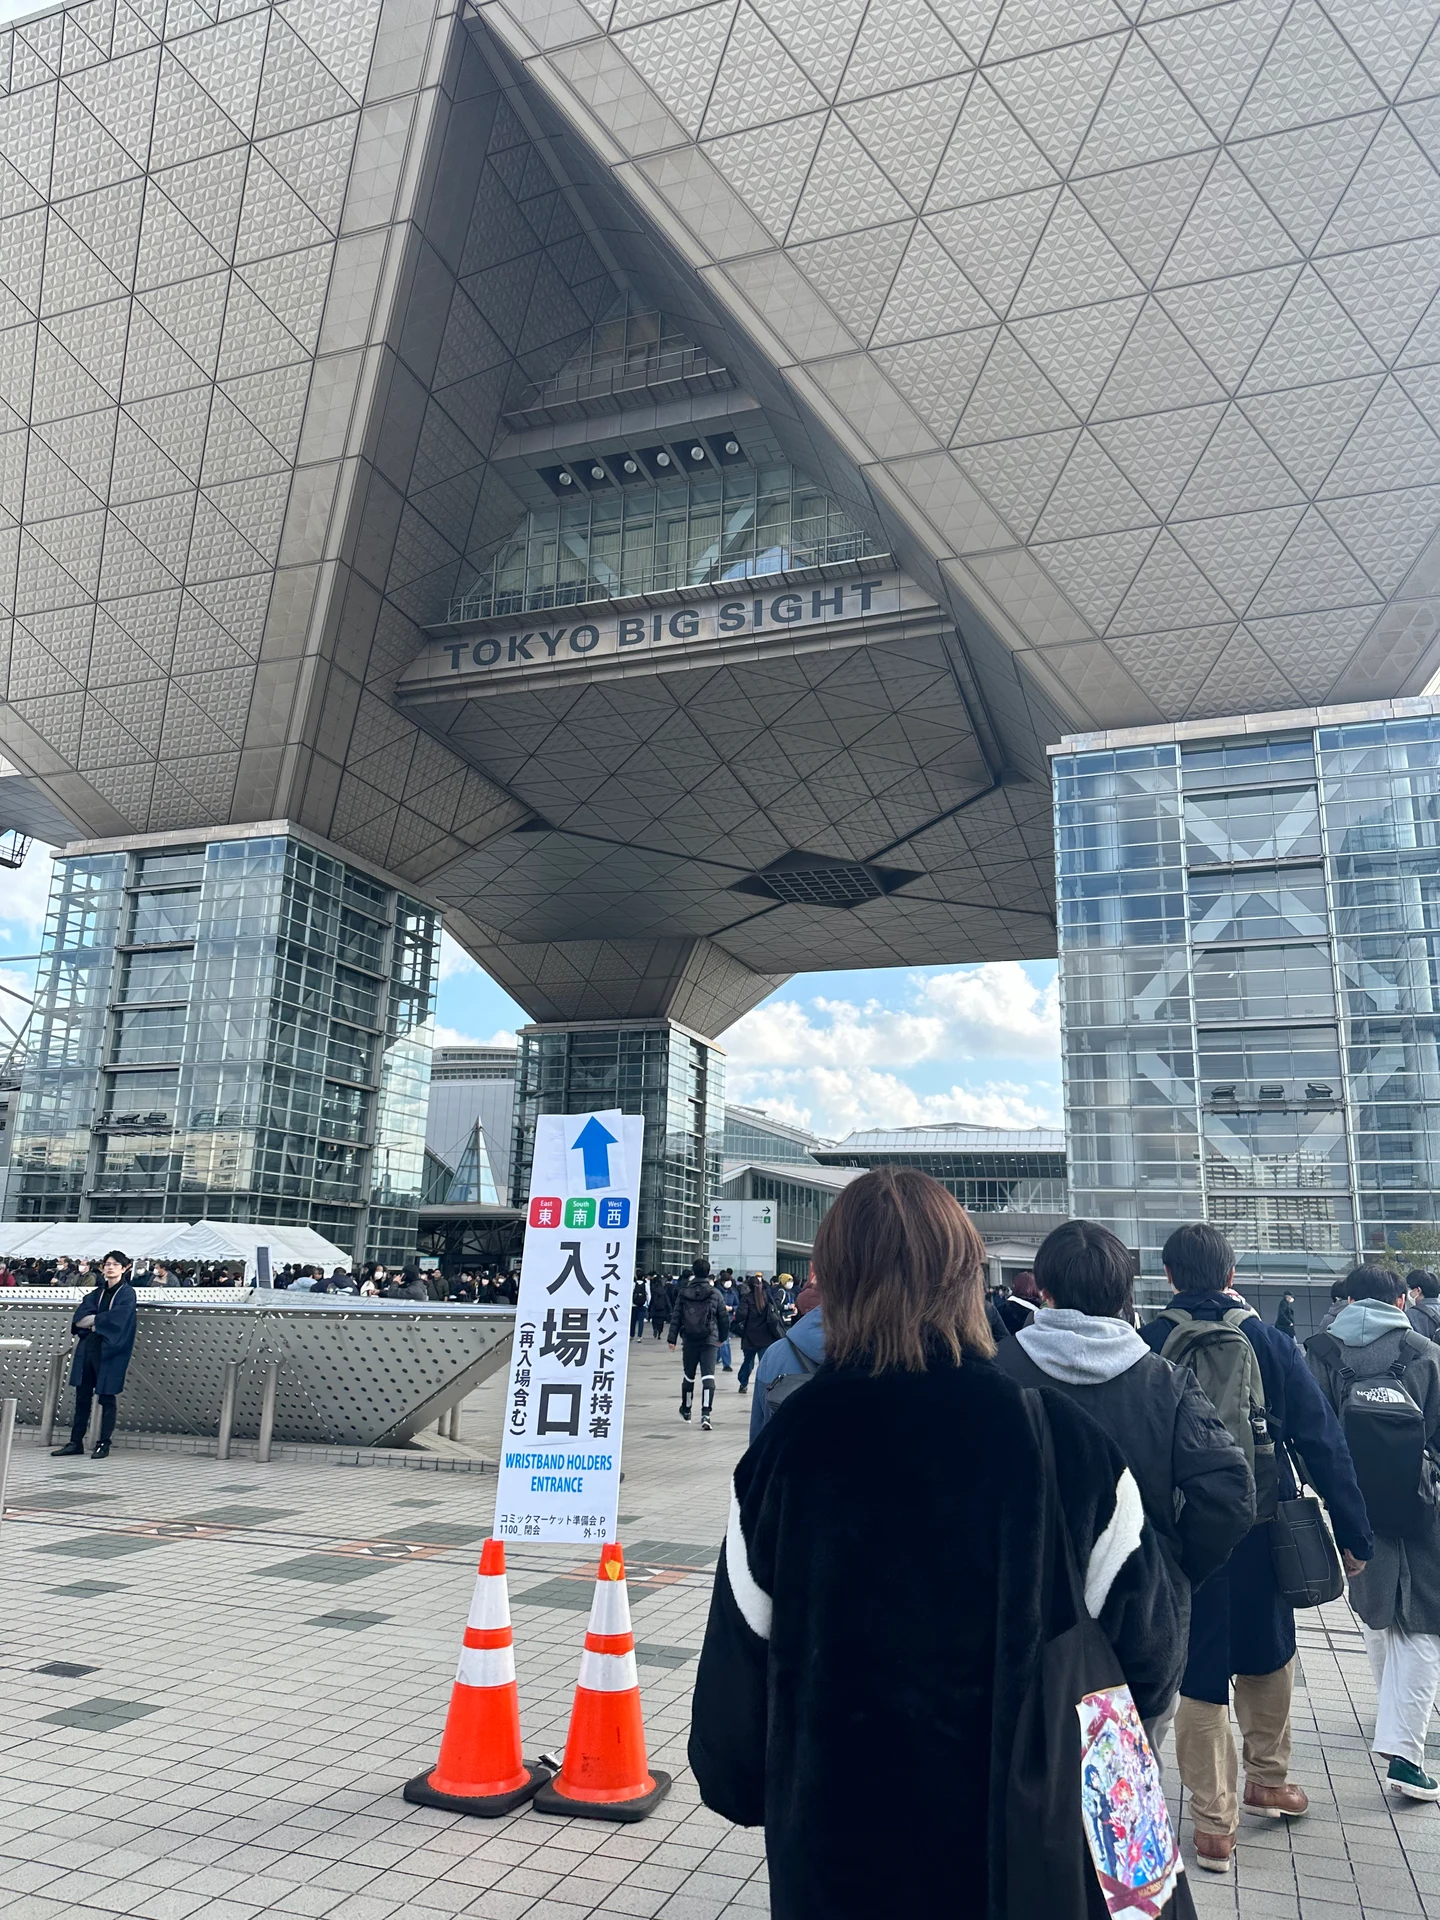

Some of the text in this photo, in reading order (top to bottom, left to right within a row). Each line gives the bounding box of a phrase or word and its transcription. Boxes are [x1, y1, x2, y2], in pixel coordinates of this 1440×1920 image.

[443, 580, 883, 669] TOKYO BIG SIGHT
[538, 1208, 553, 1225] 東
[573, 1208, 588, 1226] 南
[607, 1209, 622, 1226] 西
[537, 1242, 595, 1436] 入場口
[588, 1242, 621, 1438] リストバンド所持者
[505, 1453, 612, 1471] WRISTBAND HOLDERS
[531, 1476, 583, 1492] ENTRANCE
